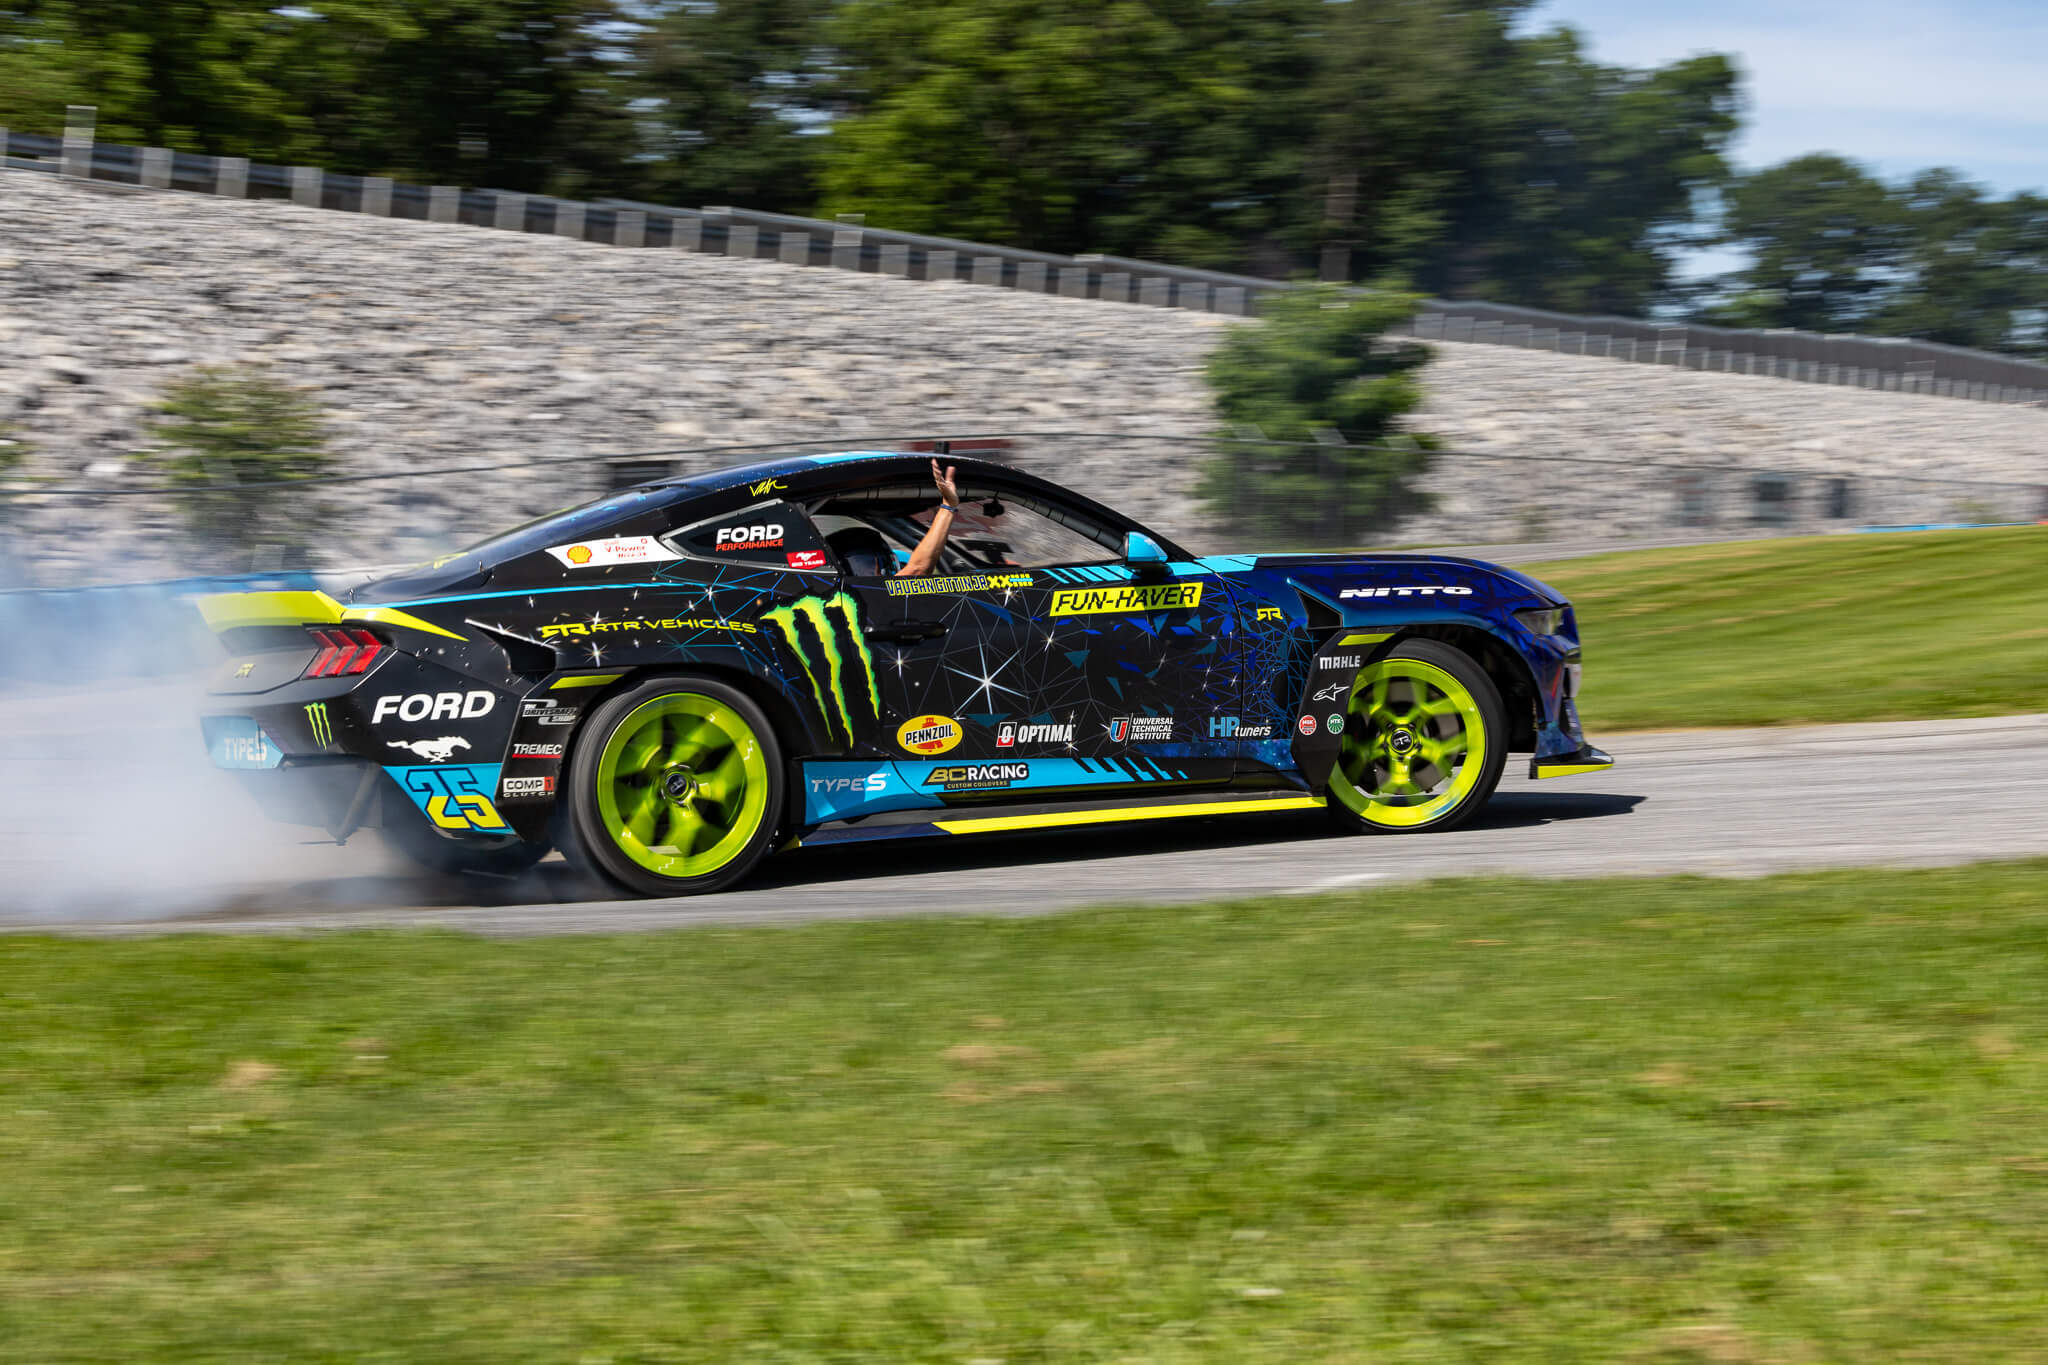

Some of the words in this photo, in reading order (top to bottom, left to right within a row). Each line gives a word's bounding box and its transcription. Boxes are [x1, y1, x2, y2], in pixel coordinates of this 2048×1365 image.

[716, 524, 784, 544] FORD
[715, 538, 784, 552] PERFORMANCE
[885, 578, 936, 596] VAUGHN
[935, 576, 972, 593] GITTIN
[1339, 586, 1473, 598] NITTO
[1055, 586, 1198, 612] FUN-HAVER
[591, 620, 641, 632] RTR
[643, 619, 758, 634] VEHICLES
[1320, 655, 1361, 670] MAHLE
[371, 690, 496, 724] FORD
[1132, 717, 1174, 725] UNIVERSAL
[1209, 716, 1241, 737] HP
[1234, 725, 1272, 737] tuners
[905, 724, 955, 745] PENNZOIL
[1017, 724, 1073, 743] OPTIMA
[1130, 732, 1172, 740] INSTITUTE
[513, 743, 562, 755] TREMEC
[967, 765, 1028, 781] RACING
[973, 780, 1008, 788] COILOVERS
[405, 767, 513, 831] 25
